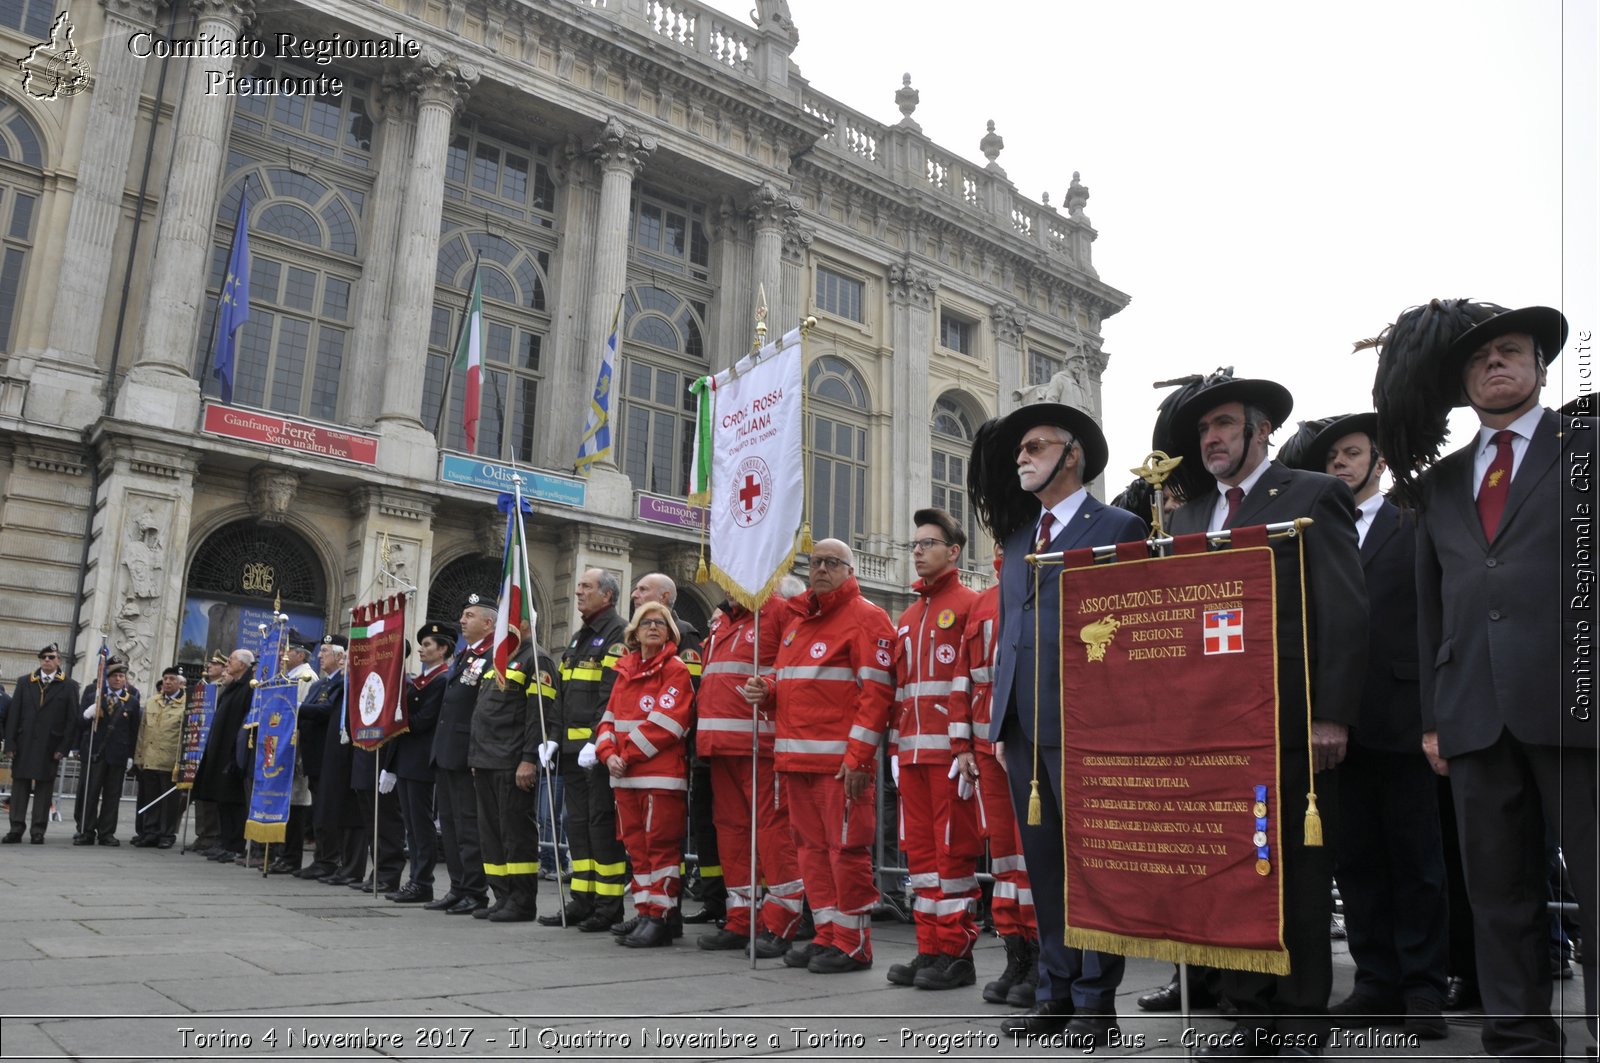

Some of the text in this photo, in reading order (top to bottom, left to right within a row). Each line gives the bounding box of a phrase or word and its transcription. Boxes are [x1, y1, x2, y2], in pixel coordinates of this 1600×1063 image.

[752, 387, 783, 413] ROSSA
[223, 413, 280, 435] Gianfranco
[280, 421, 316, 441] Ferré
[265, 432, 291, 446] Sotto
[328, 444, 348, 458] luce
[482, 464, 528, 486] Odise
[651, 499, 698, 520] Giansone
[1077, 580, 1244, 615] ASSOCIAZIONE NAZIONALE
[1203, 600, 1243, 612] PIEMONTE
[1121, 607, 1196, 626] BERSAGLIERI
[1132, 627, 1184, 642] REGIONE
[1128, 645, 1187, 661] PIEMONTE
[1139, 756, 1172, 766] LAZZARO
[1173, 756, 1186, 766] AD
[1098, 776, 1123, 787] ORDINI
[1123, 777, 1155, 787] MILITARI
[1091, 799, 1100, 808] 20
[1100, 799, 1137, 811] MEDAGLIE
[1162, 801, 1175, 812] AL
[1177, 801, 1207, 812] VALOR
[1208, 801, 1249, 812] MILITARE
[1104, 820, 1143, 831] MEDAGLIE
[1192, 823, 1204, 833] AL
[1090, 838, 1106, 849] 1113
[1106, 840, 1147, 852] MEDAGLIE
[1147, 842, 1156, 852] DI
[1157, 842, 1195, 854] BRONZO
[1196, 844, 1209, 854] AL
[1090, 858, 1103, 869] 310
[1104, 859, 1129, 871] CROCI
[1129, 861, 1139, 871] DI
[1139, 862, 1174, 874] GUERRA
[1175, 863, 1188, 874] AL
